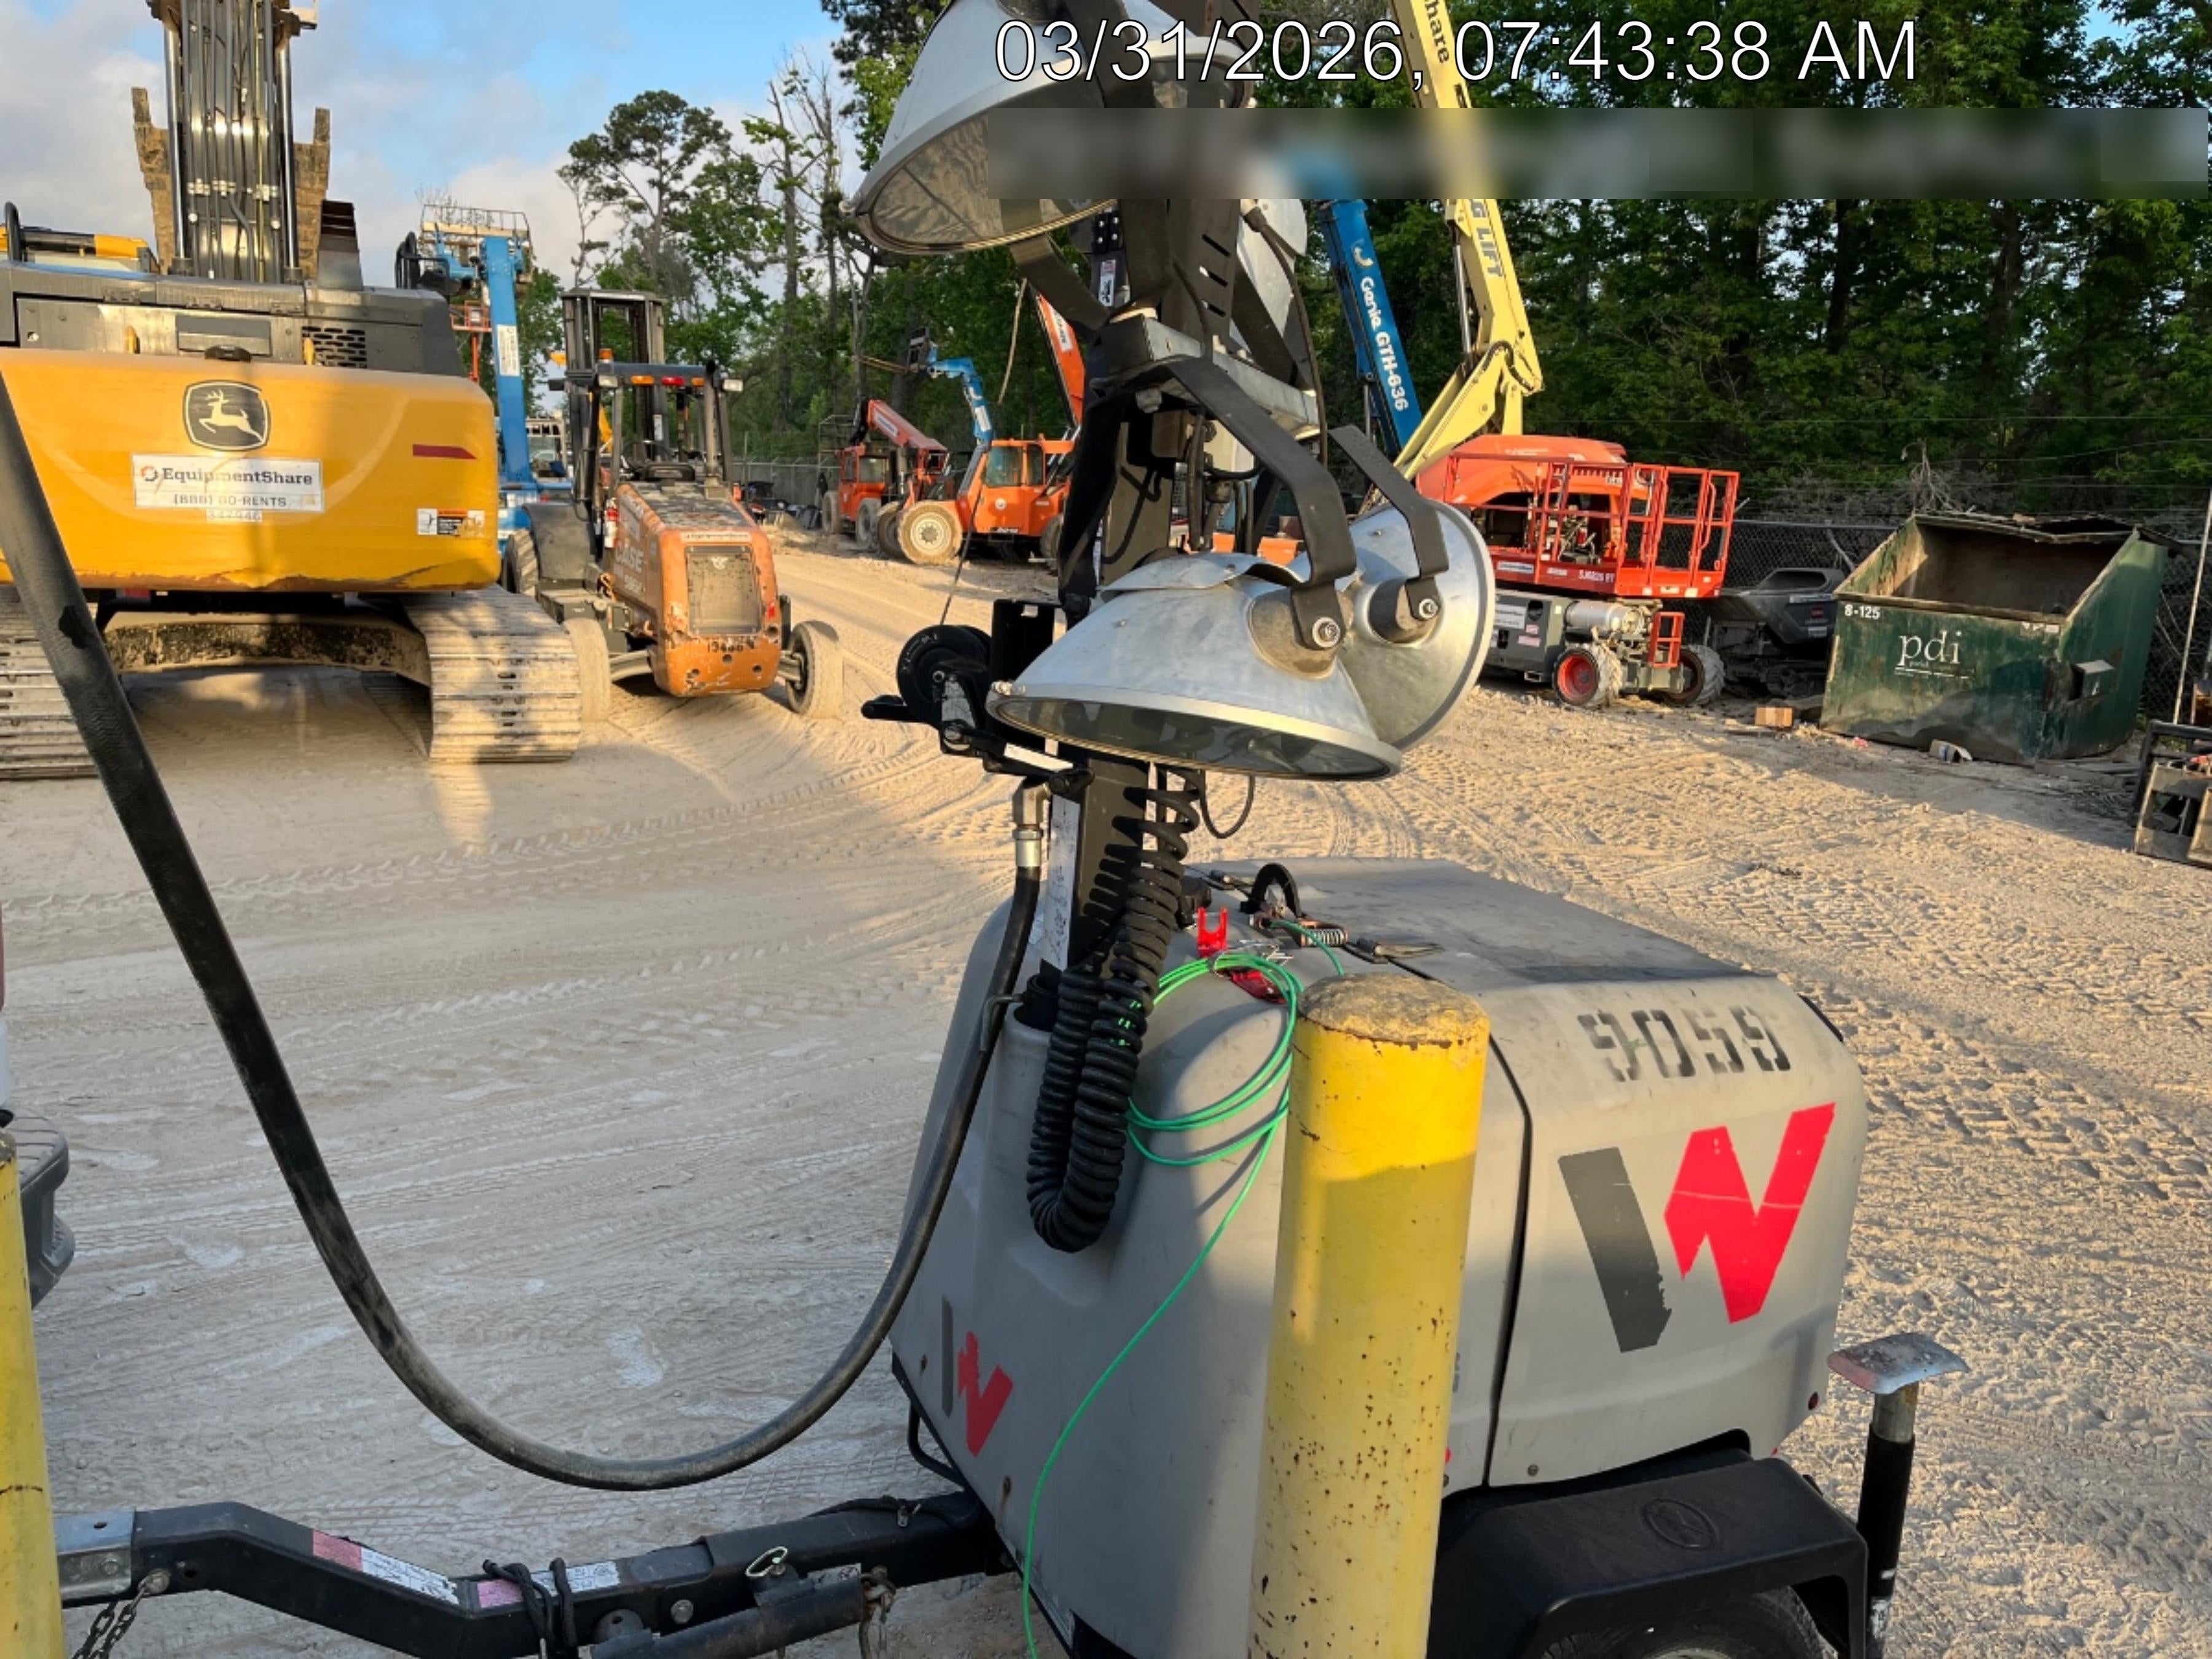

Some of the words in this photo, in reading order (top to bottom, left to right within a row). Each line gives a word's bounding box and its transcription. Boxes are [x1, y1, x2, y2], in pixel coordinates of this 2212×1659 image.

[1477, 227, 1504, 276] LIFT
[1360, 276, 1382, 331] Genie
[1375, 331, 1410, 412] GTH-636
[162, 467, 313, 485] EquipmentShare
[1845, 604, 1881, 620] 8-125
[1897, 629, 1963, 666] pdi
[1577, 1005, 1791, 1083] 9059
